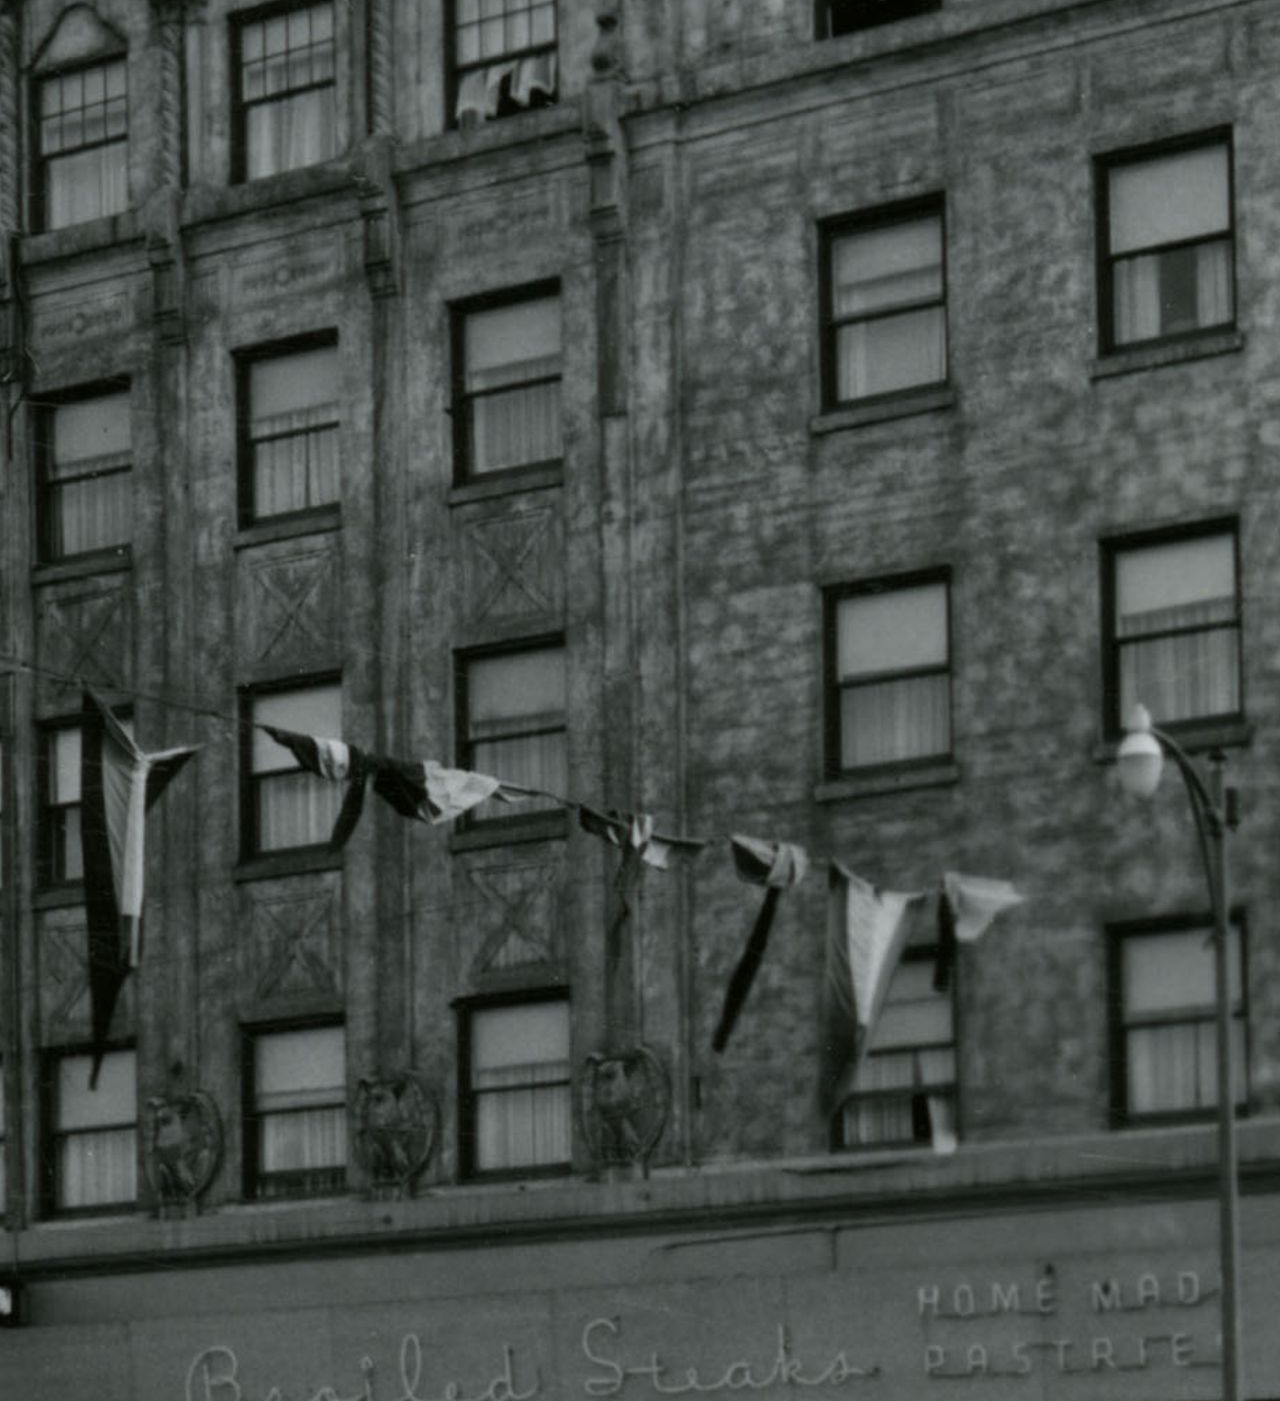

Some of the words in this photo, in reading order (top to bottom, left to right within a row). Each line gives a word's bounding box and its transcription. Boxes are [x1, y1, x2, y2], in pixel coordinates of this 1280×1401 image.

[919, 1275, 1057, 1316] HOME
[1092, 1271, 1224, 1312] MAD
[582, 1316, 882, 1395] Steaks
[924, 1333, 1224, 1377] PASTRIE
